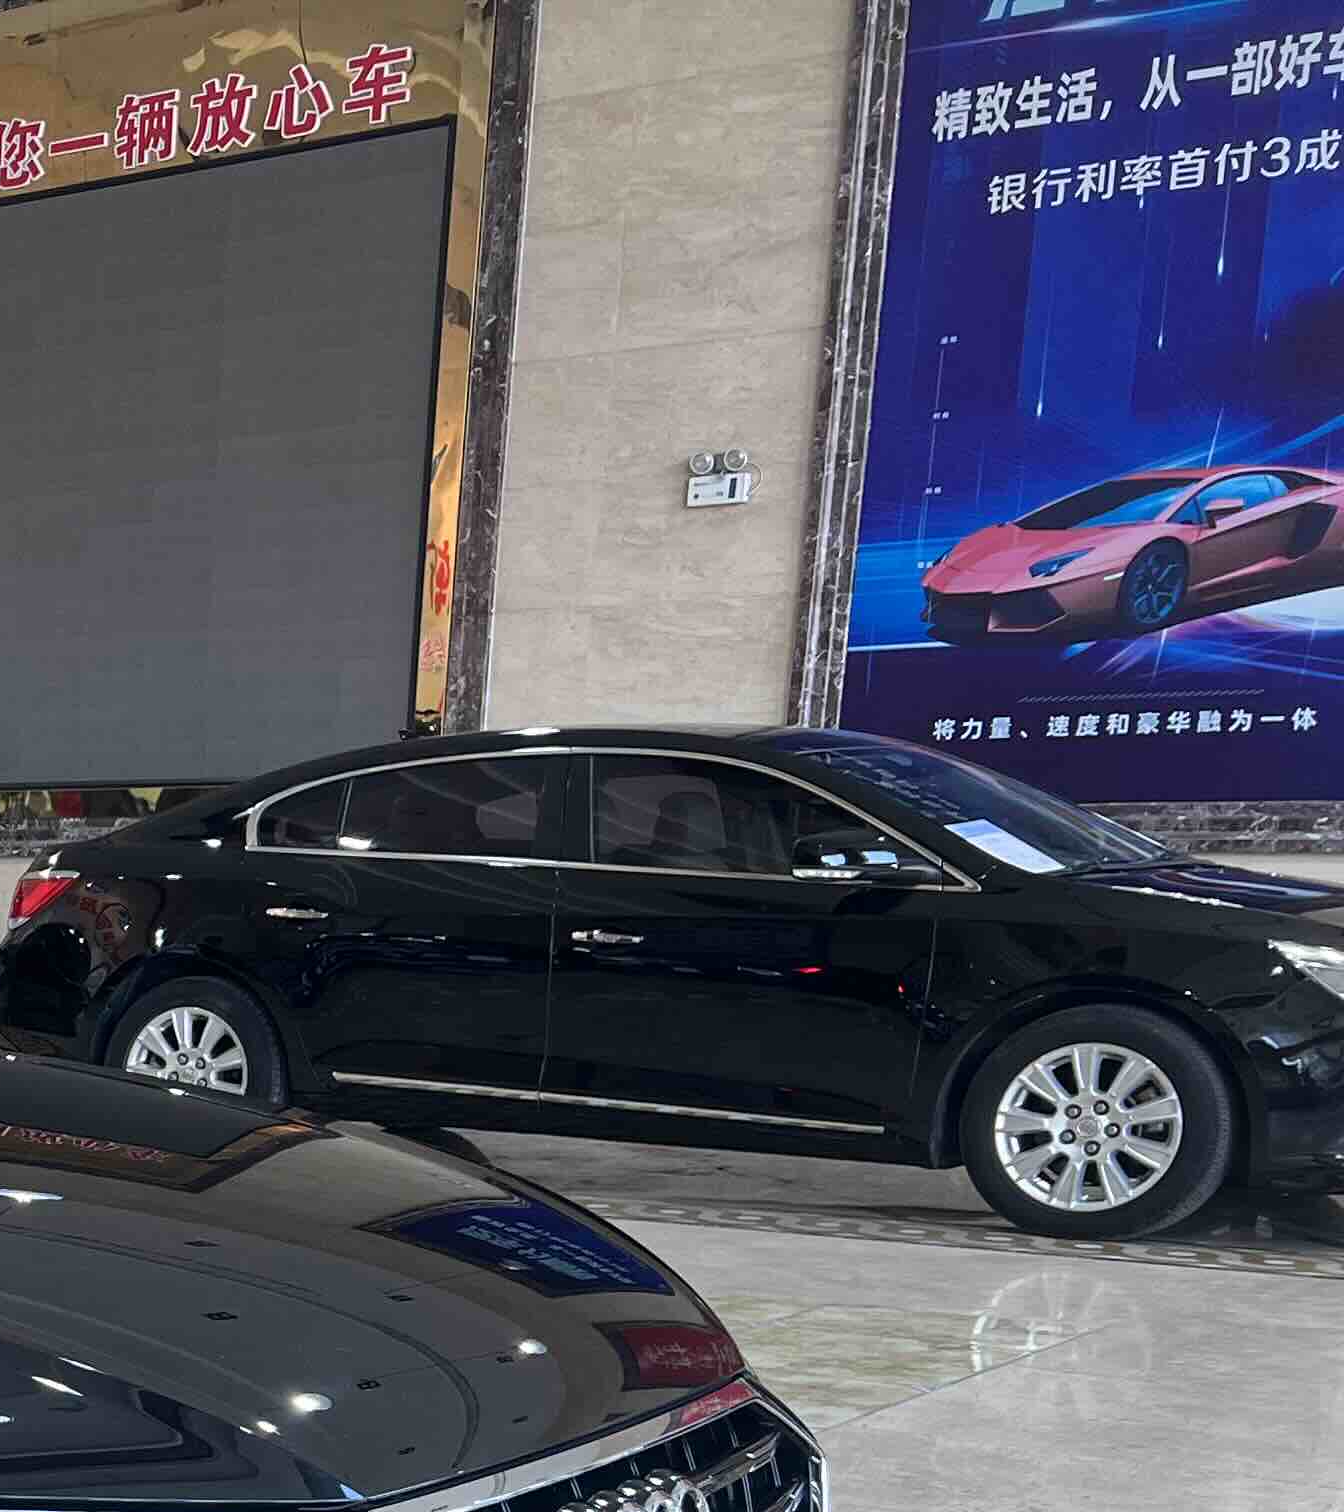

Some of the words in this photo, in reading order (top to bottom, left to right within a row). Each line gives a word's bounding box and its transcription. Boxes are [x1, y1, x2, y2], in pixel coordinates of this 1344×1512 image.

[932, 707, 1319, 743] 将力量、速度和豪华融为一体
